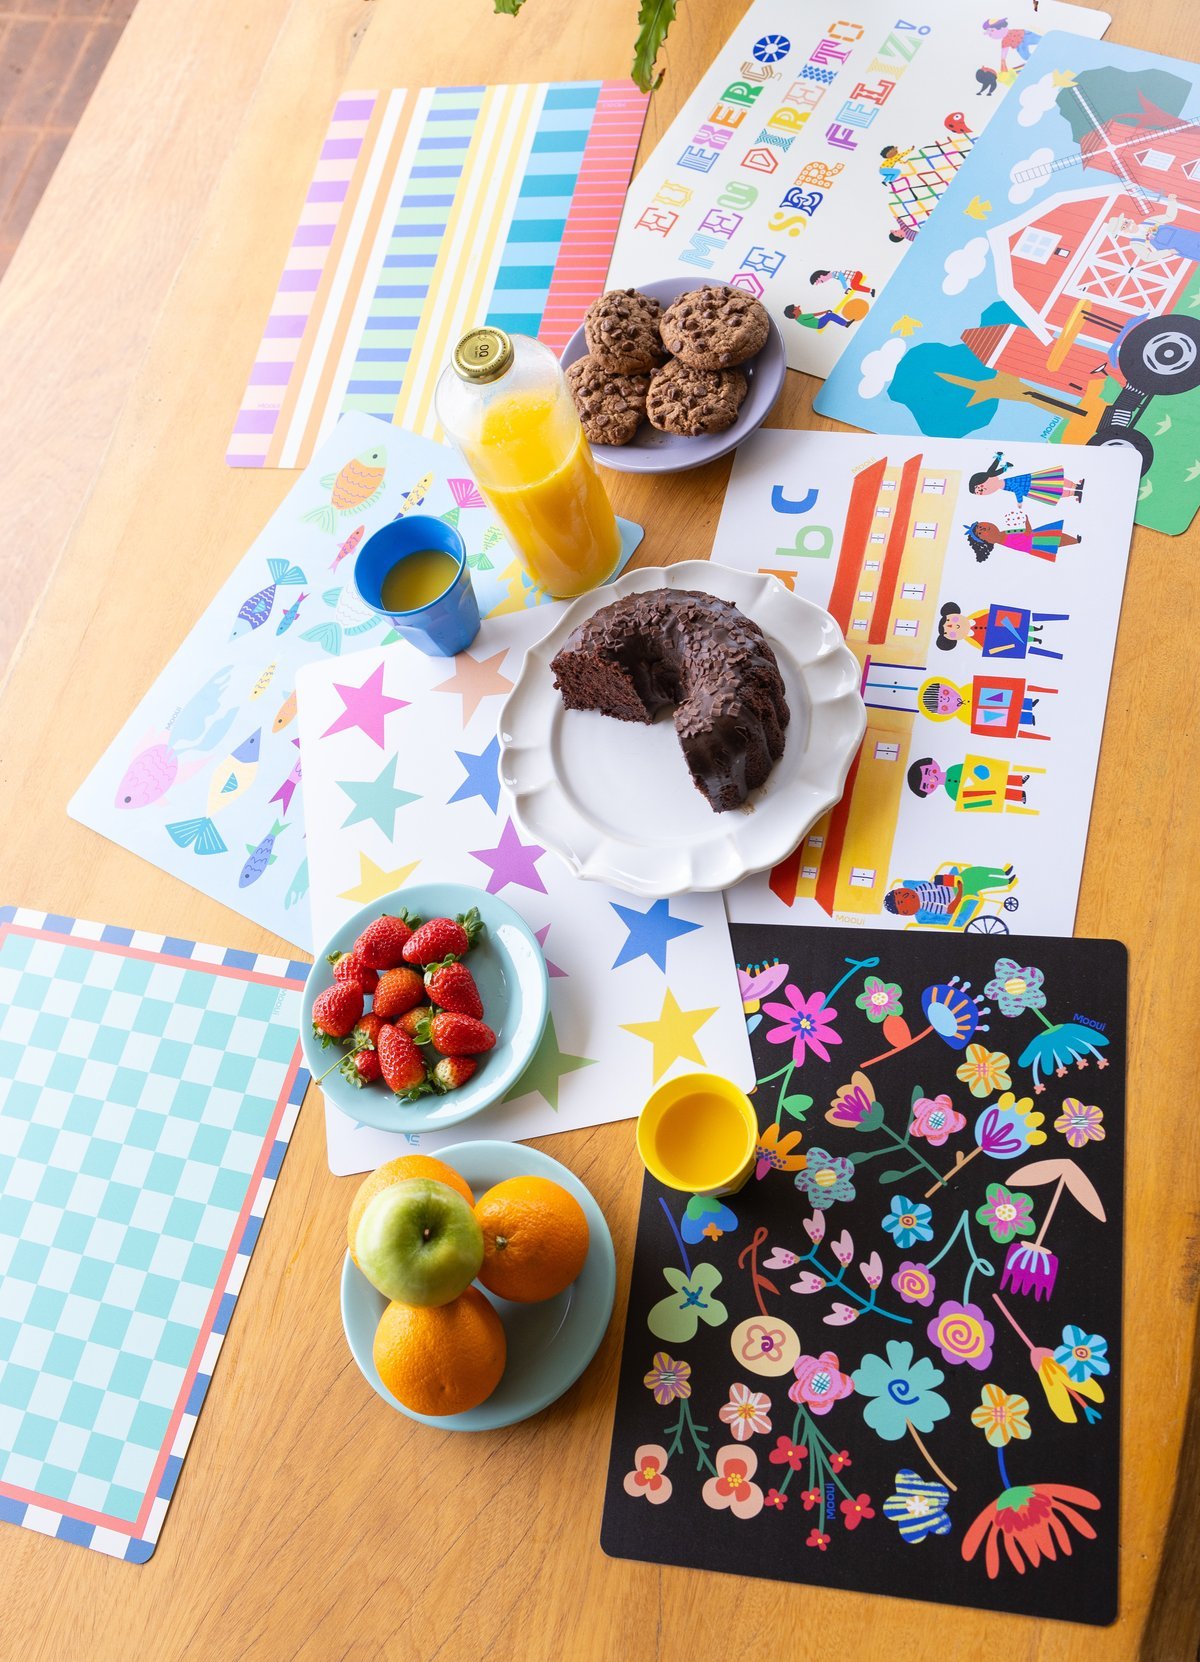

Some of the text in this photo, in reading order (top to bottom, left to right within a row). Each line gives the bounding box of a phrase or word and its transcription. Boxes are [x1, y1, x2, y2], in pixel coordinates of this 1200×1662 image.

[634, 34, 791, 239] EU EXERÇO
[678, 20, 864, 270] MEU DIREITO
[767, 161, 846, 238] SER
[825, 18, 931, 152] FELIZ!
